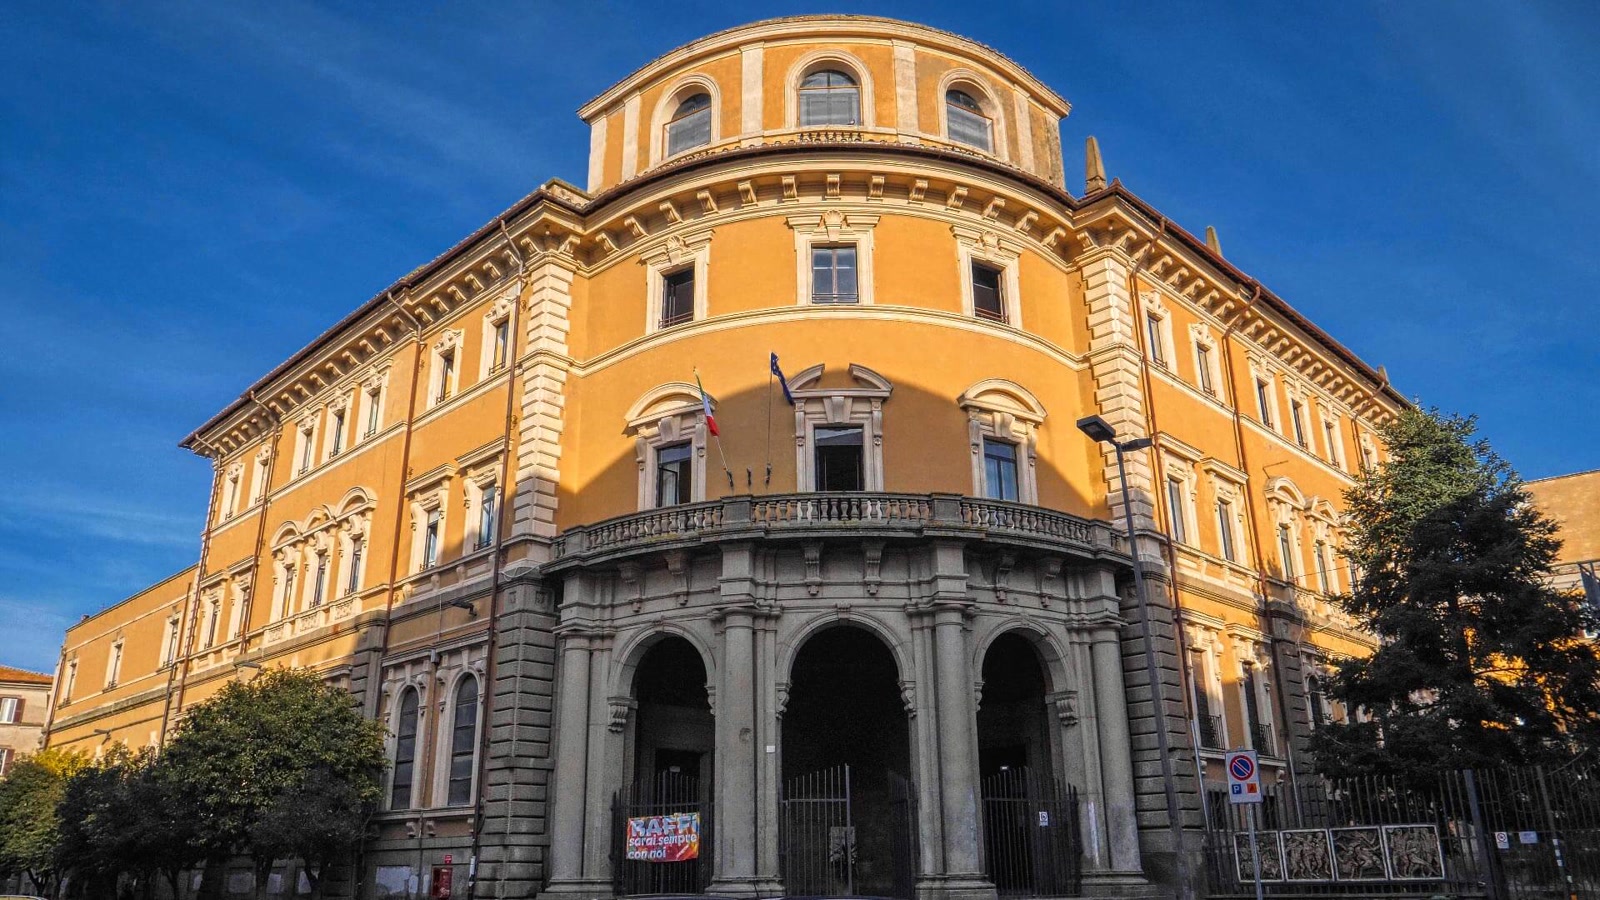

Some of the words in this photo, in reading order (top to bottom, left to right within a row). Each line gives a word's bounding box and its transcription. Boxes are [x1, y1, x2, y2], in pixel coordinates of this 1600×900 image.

[629, 834, 656, 846] sarai
[658, 833, 697, 846] sempre
[628, 850, 648, 859] con
[649, 847, 666, 859] noi
